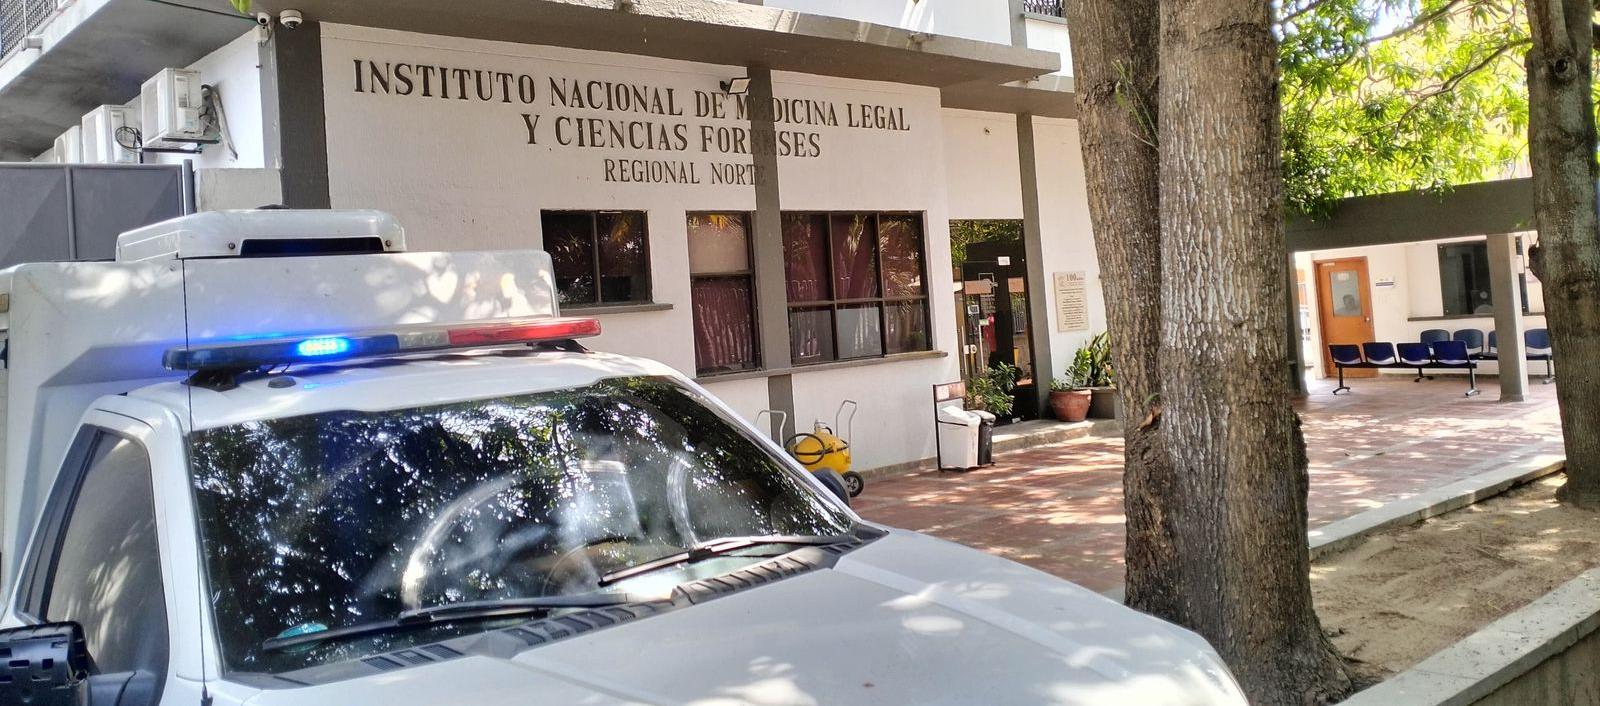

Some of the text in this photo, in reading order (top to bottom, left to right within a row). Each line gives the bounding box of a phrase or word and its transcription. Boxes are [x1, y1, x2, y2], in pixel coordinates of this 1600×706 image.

[353, 59, 911, 131] INSTITUTO NACIONAL DE MDICINA LEGAL
[520, 114, 821, 158] Y CIENCIAS FORSES
[604, 158, 765, 186] REGIONAL NORT
